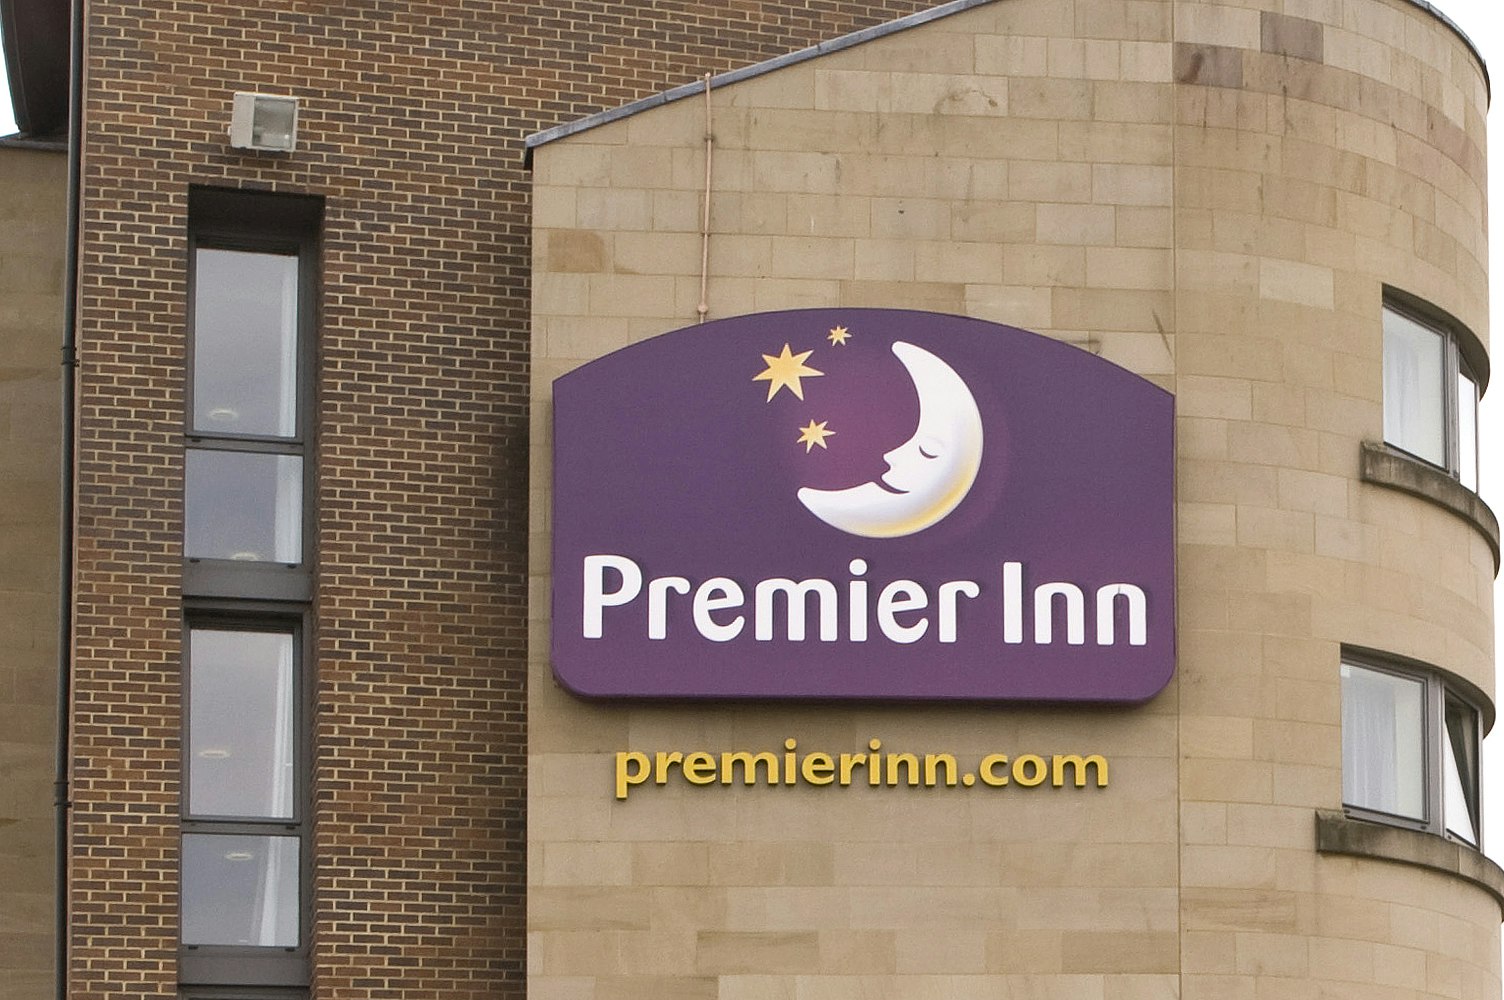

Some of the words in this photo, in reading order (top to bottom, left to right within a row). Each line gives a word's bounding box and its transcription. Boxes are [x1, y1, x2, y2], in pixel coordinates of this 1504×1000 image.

[582, 554, 980, 644] Premier
[1002, 561, 1148, 646] Inn
[615, 738, 1110, 799] premierinn.com
